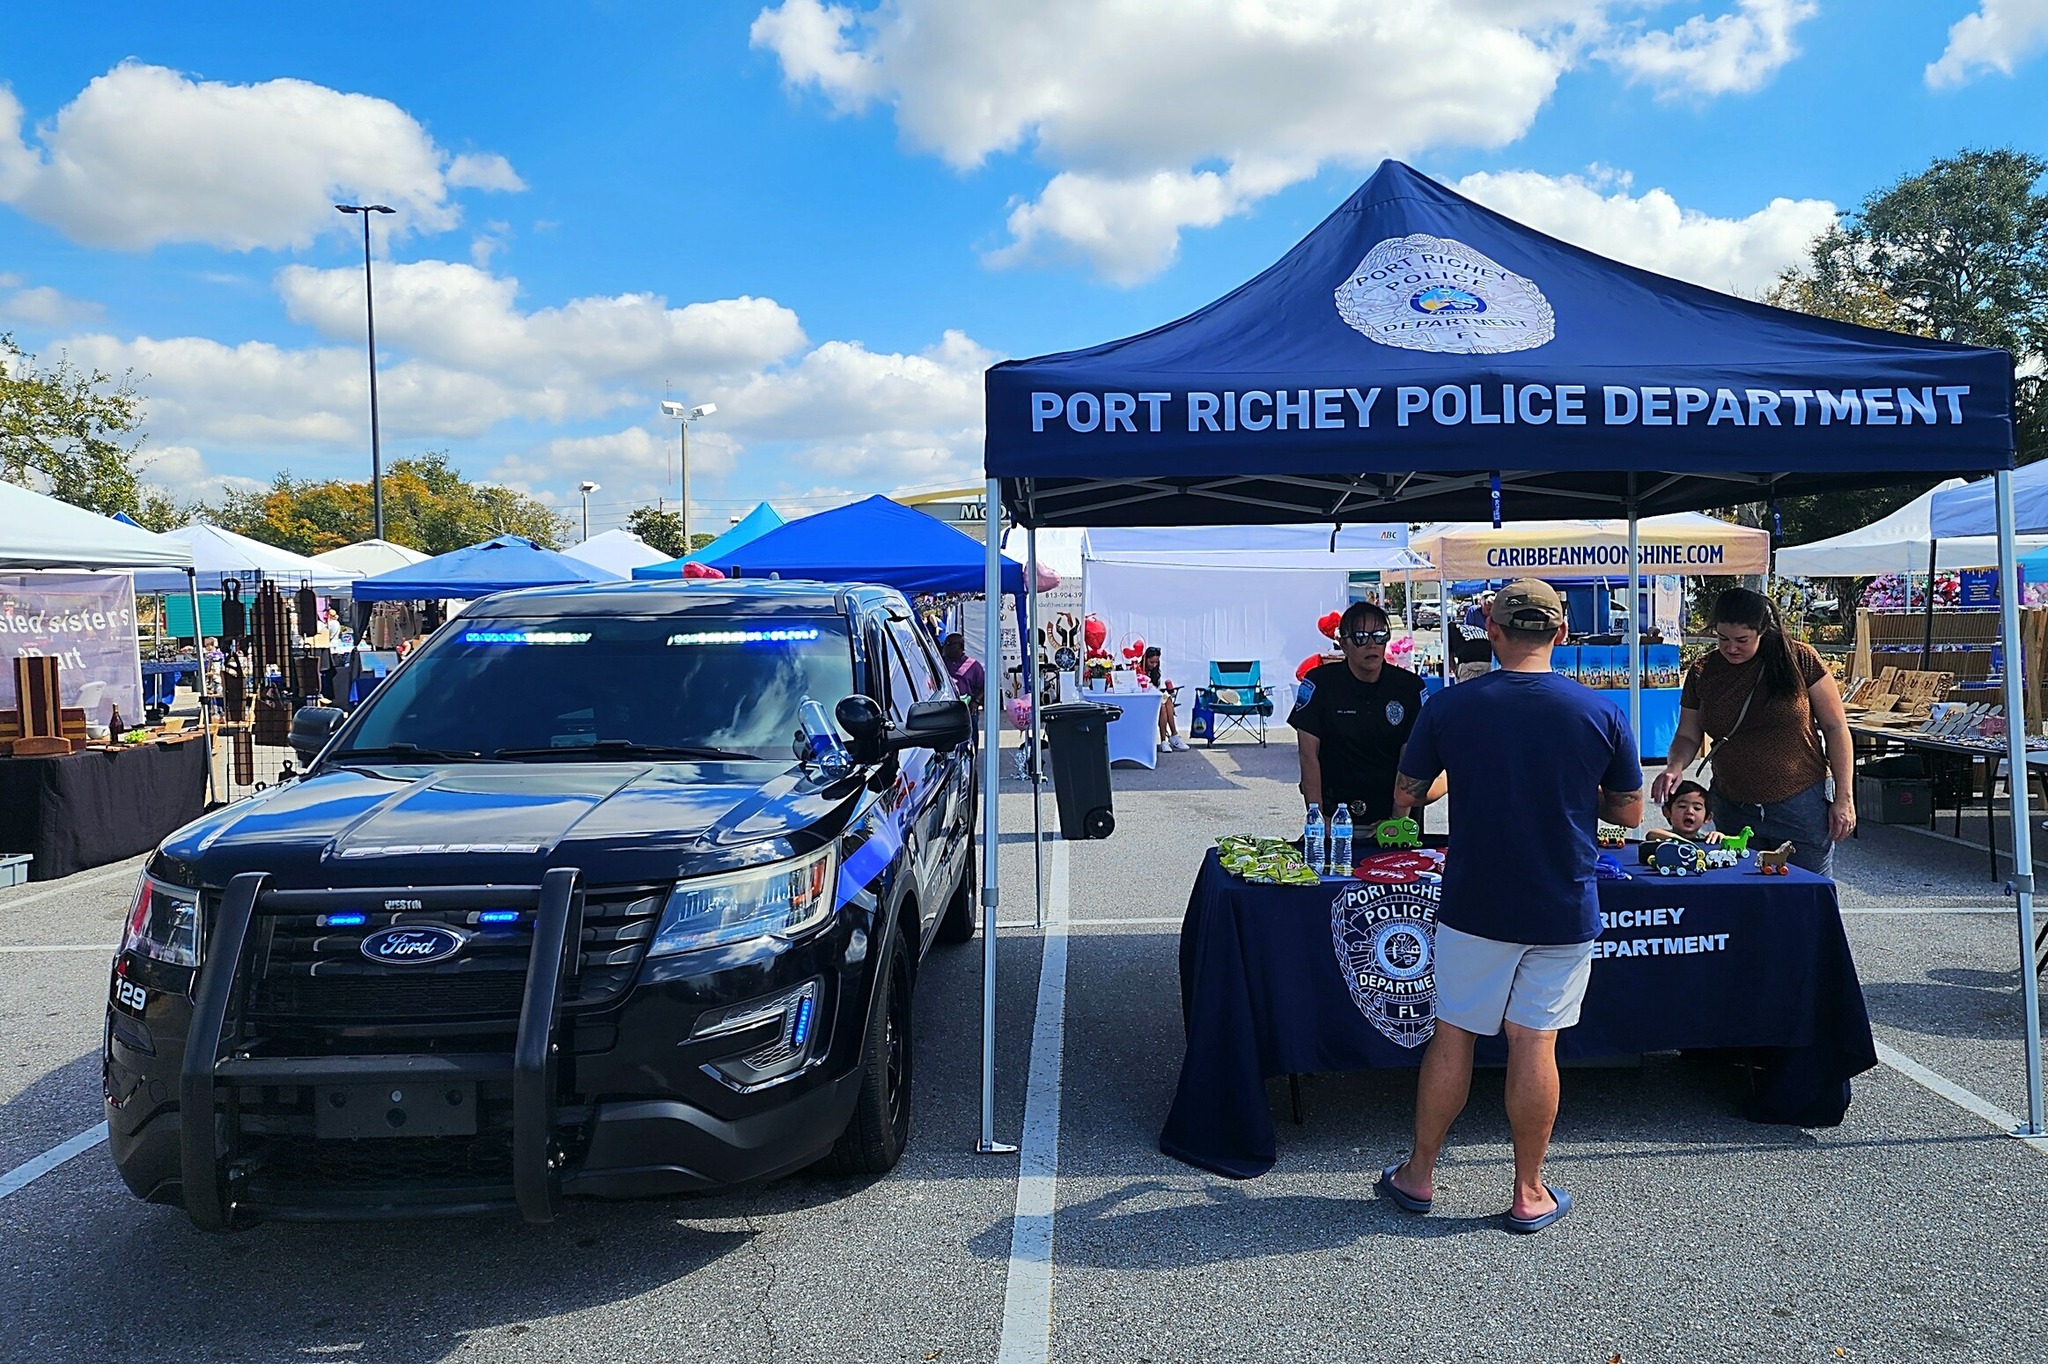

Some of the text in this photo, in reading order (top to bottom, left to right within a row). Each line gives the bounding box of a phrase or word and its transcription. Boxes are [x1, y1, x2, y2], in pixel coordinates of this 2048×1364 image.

[1356, 254, 1507, 286] PORT RICHEY
[1386, 272, 1488, 291] POLICE
[1384, 318, 1527, 332] DEPARTMENT
[1031, 384, 1970, 433] PORT RICHEY POLICE DEPARTMENT
[1381, 531, 1397, 539] ABC
[1487, 545, 1723, 566] CARIBBEANMOONSHINE.COM
[48, 608, 129, 633] sisters
[384, 899, 422, 910] WESTIN
[1347, 885, 1442, 907] PORT RICHE
[1365, 904, 1435, 925] POLICE
[1600, 907, 1685, 929] RICHEY
[380, 933, 437, 955] Ford
[1591, 933, 1730, 959] EPARTMENT
[1388, 965, 1421, 977] FLORIDA
[1359, 973, 1436, 994] DEPARTME
[116, 979, 147, 1011] 129
[1399, 1005, 1420, 1019] FL
